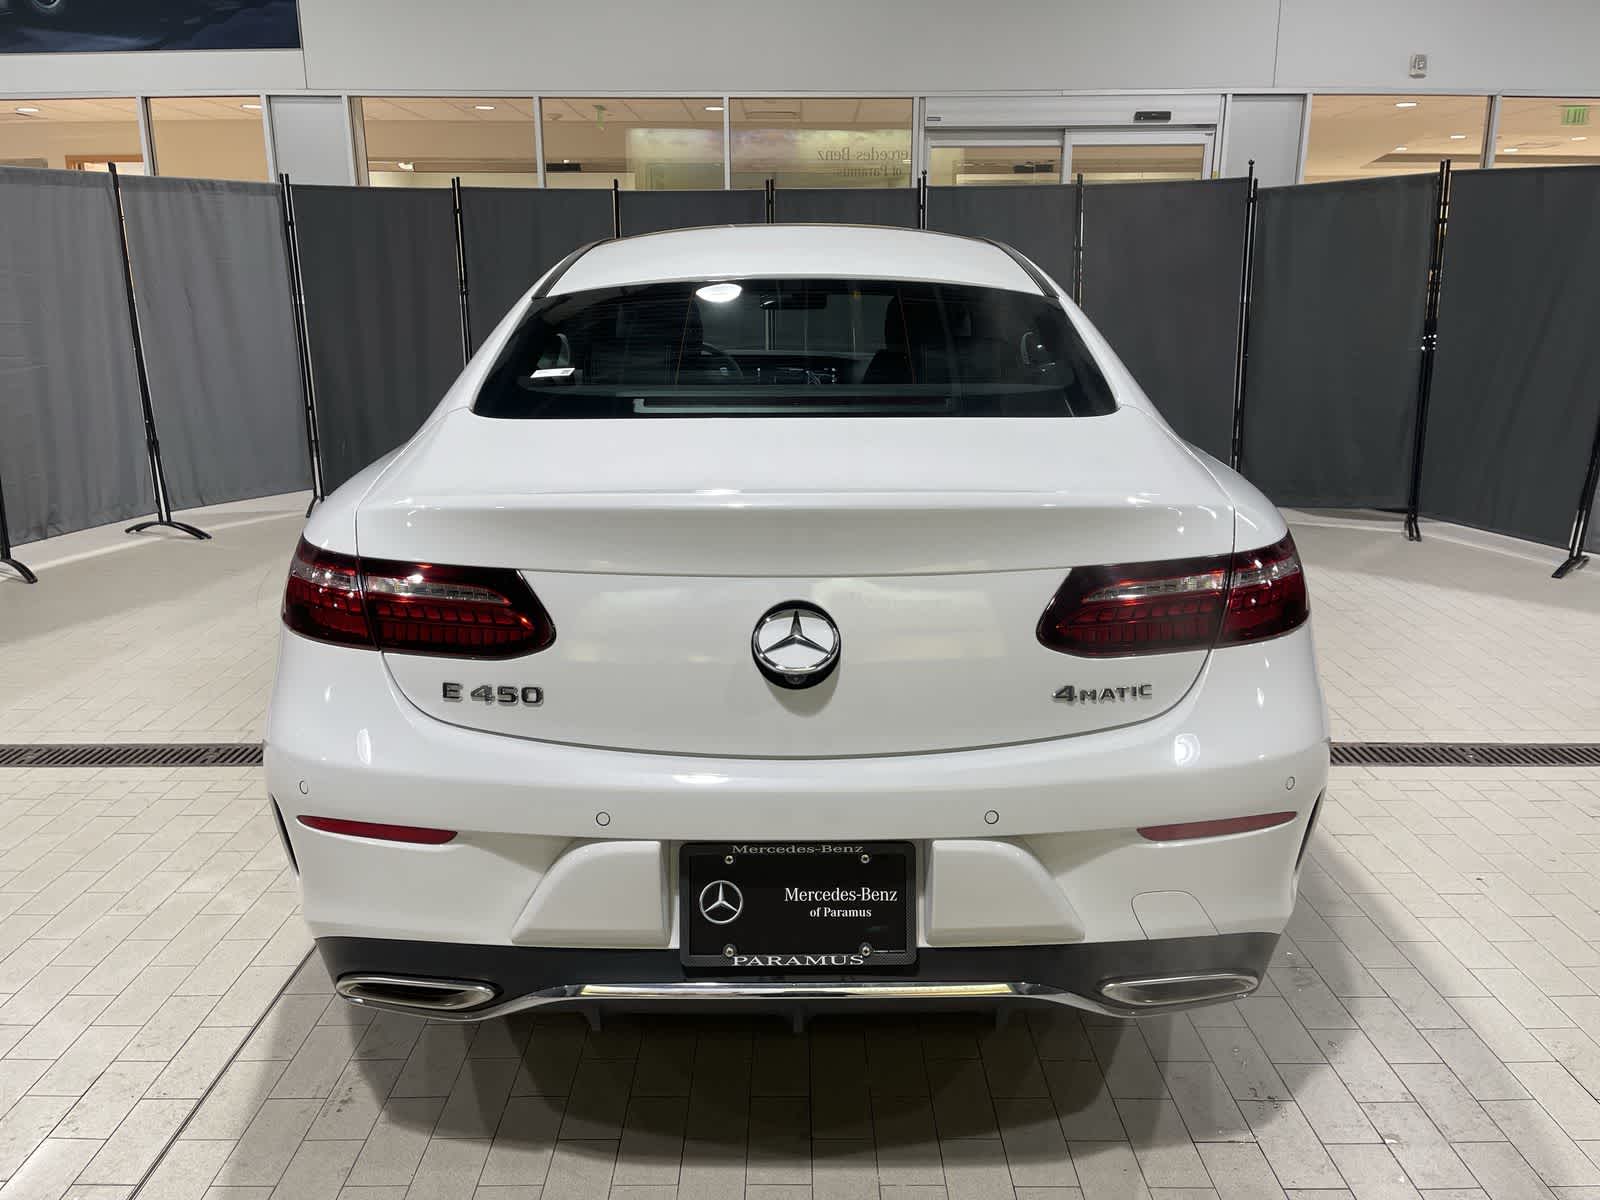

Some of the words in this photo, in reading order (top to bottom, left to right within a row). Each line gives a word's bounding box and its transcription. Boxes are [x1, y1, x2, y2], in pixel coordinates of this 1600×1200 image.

[442, 682, 463, 702] E
[470, 684, 544, 707] 450
[1051, 684, 1153, 706] 4MATIC
[731, 844, 864, 854] Mercedes-Benz
[784, 887, 898, 902] Mercedes-Benz
[809, 906, 821, 918] of
[823, 907, 872, 918] Paramus
[732, 954, 865, 966] PARAMUS
